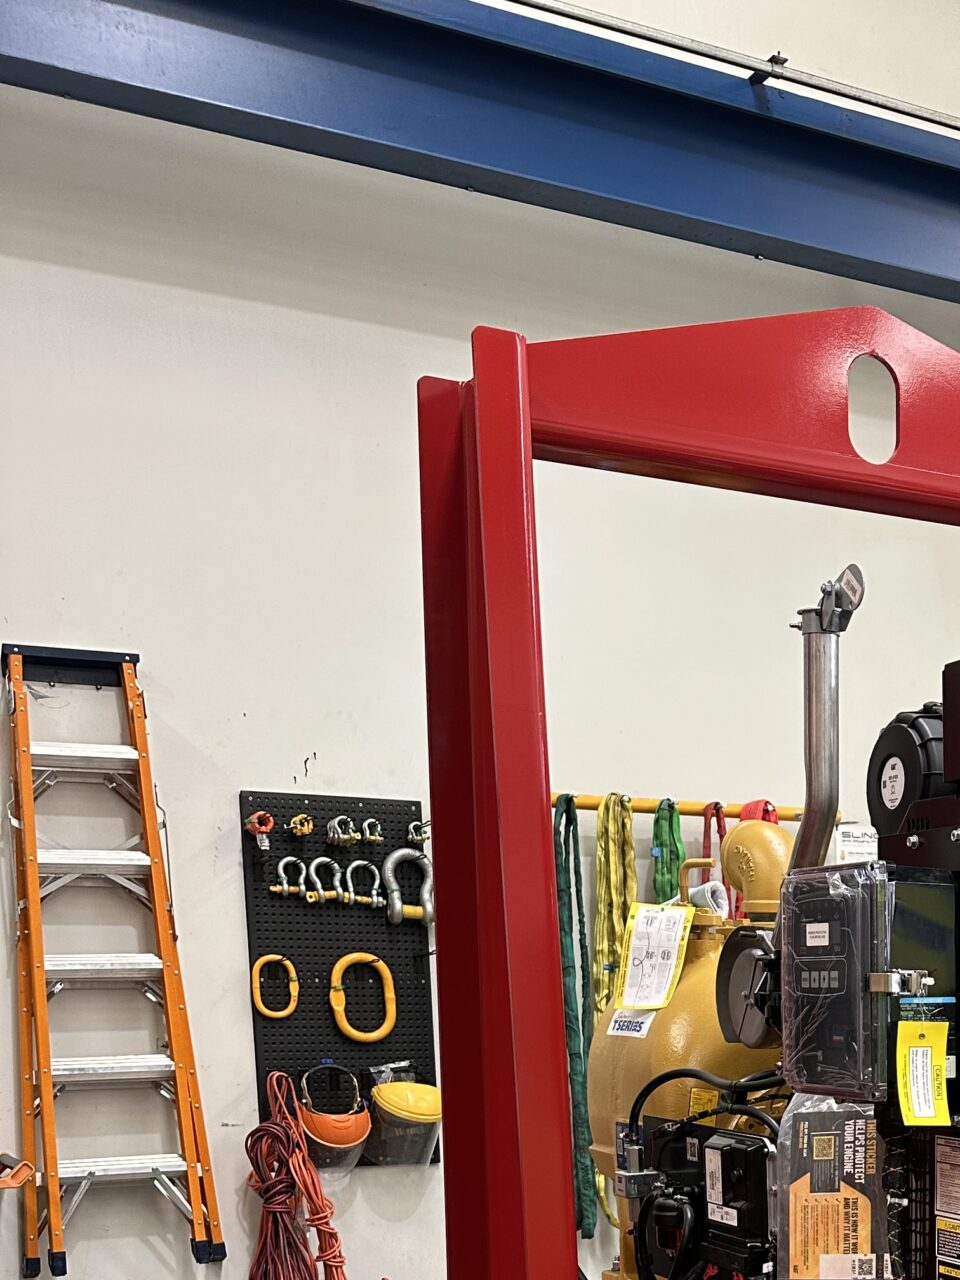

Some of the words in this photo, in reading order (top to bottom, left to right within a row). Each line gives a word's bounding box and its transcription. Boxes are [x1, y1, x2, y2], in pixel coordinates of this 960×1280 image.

[844, 1120, 855, 1142] YOUR
[855, 1119, 866, 1146] HELPS
[866, 1119, 877, 1138] THIS
[843, 1143, 854, 1176] ENGINE.
[854, 1147, 865, 1184] PROTECT
[866, 1138, 877, 1175] STICKER
